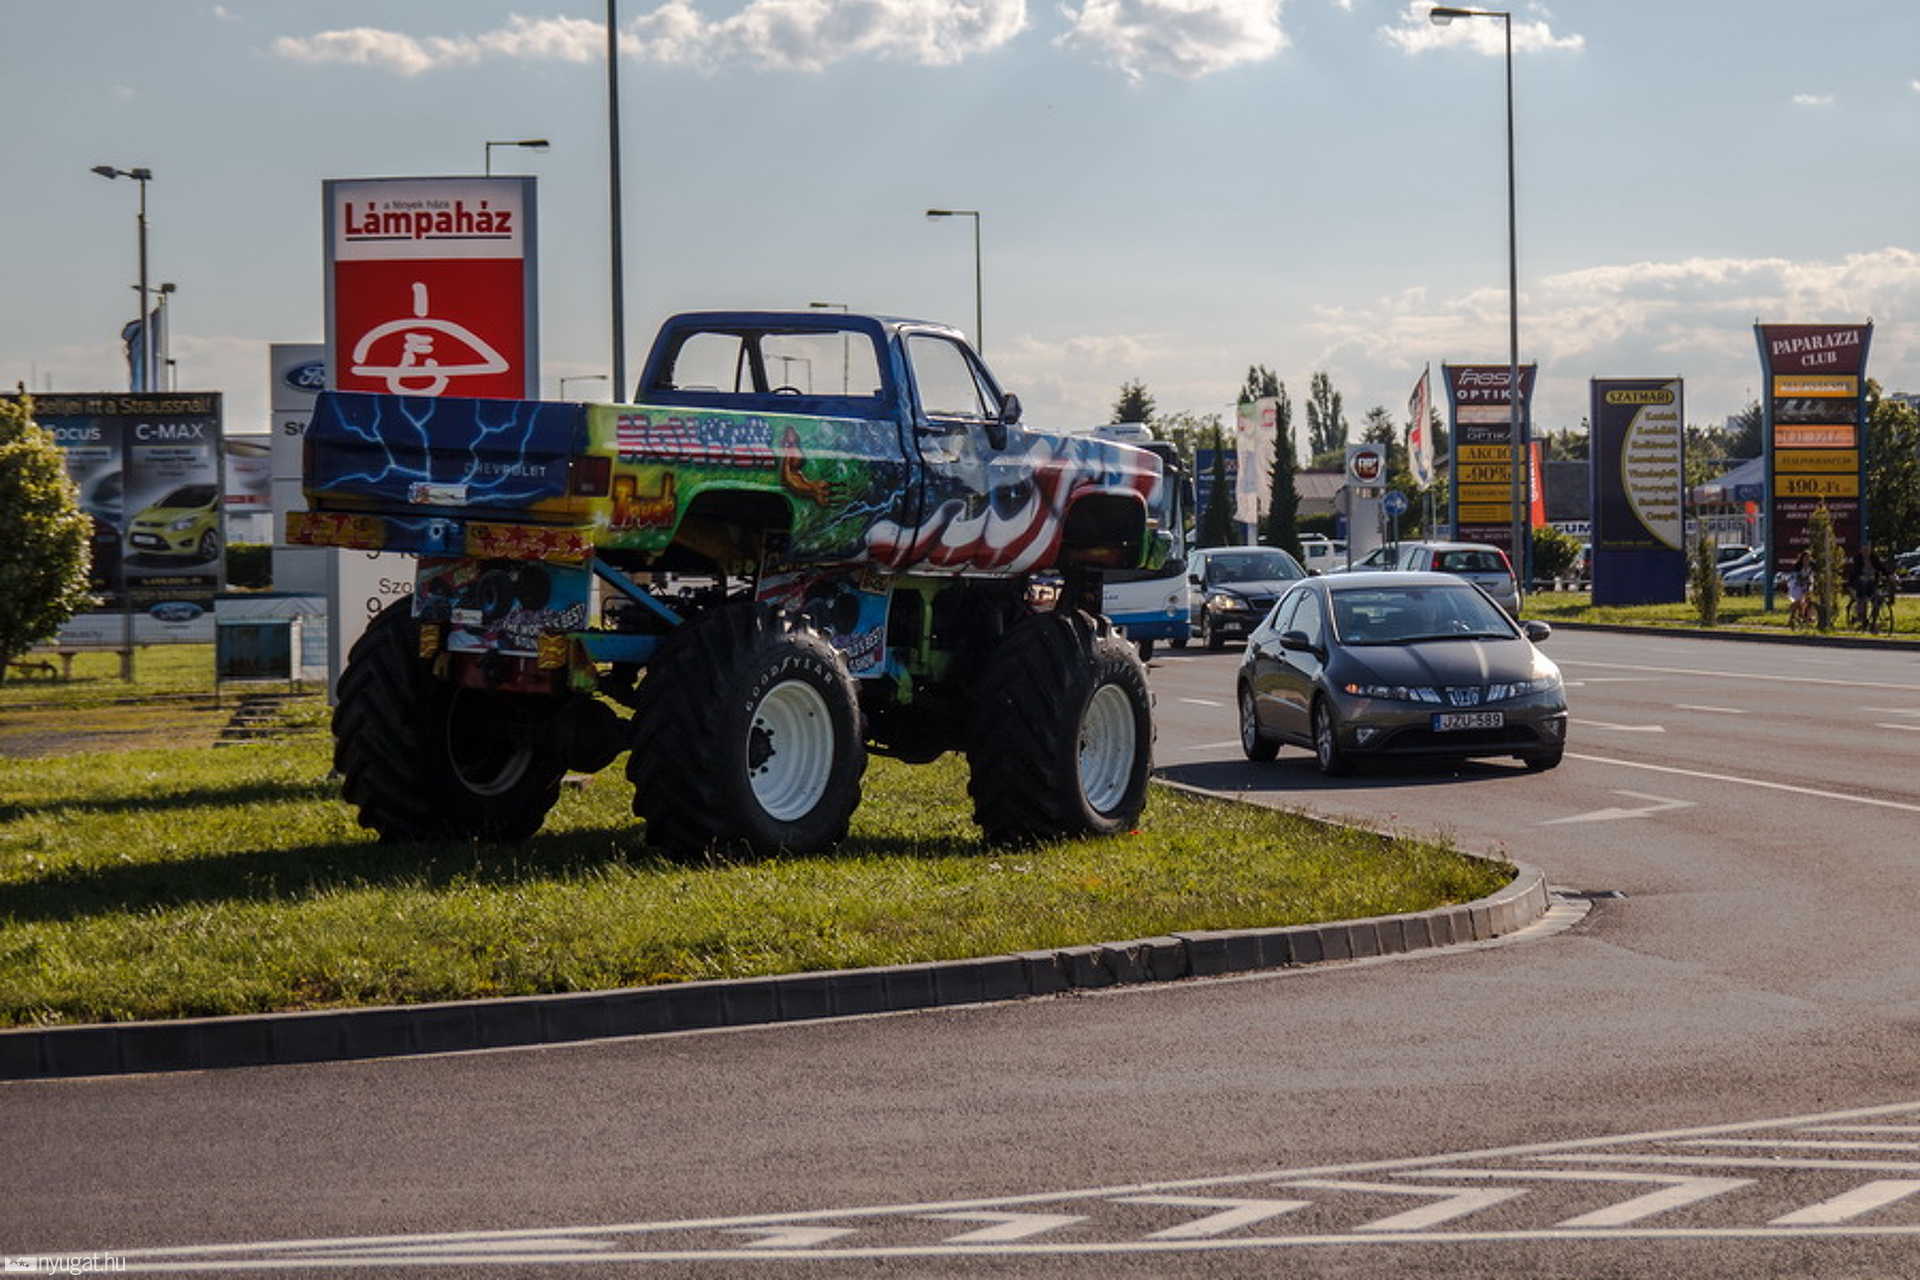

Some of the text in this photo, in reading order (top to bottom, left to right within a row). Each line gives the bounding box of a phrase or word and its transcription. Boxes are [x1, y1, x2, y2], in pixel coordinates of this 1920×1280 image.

[345, 200, 512, 239] Lámpaház
[1772, 330, 1859, 355] PAPARAZZI
[1801, 351, 1837, 366] CLUB
[136, 423, 204, 440] C-MAX
[463, 462, 547, 477] CHEVROLET
